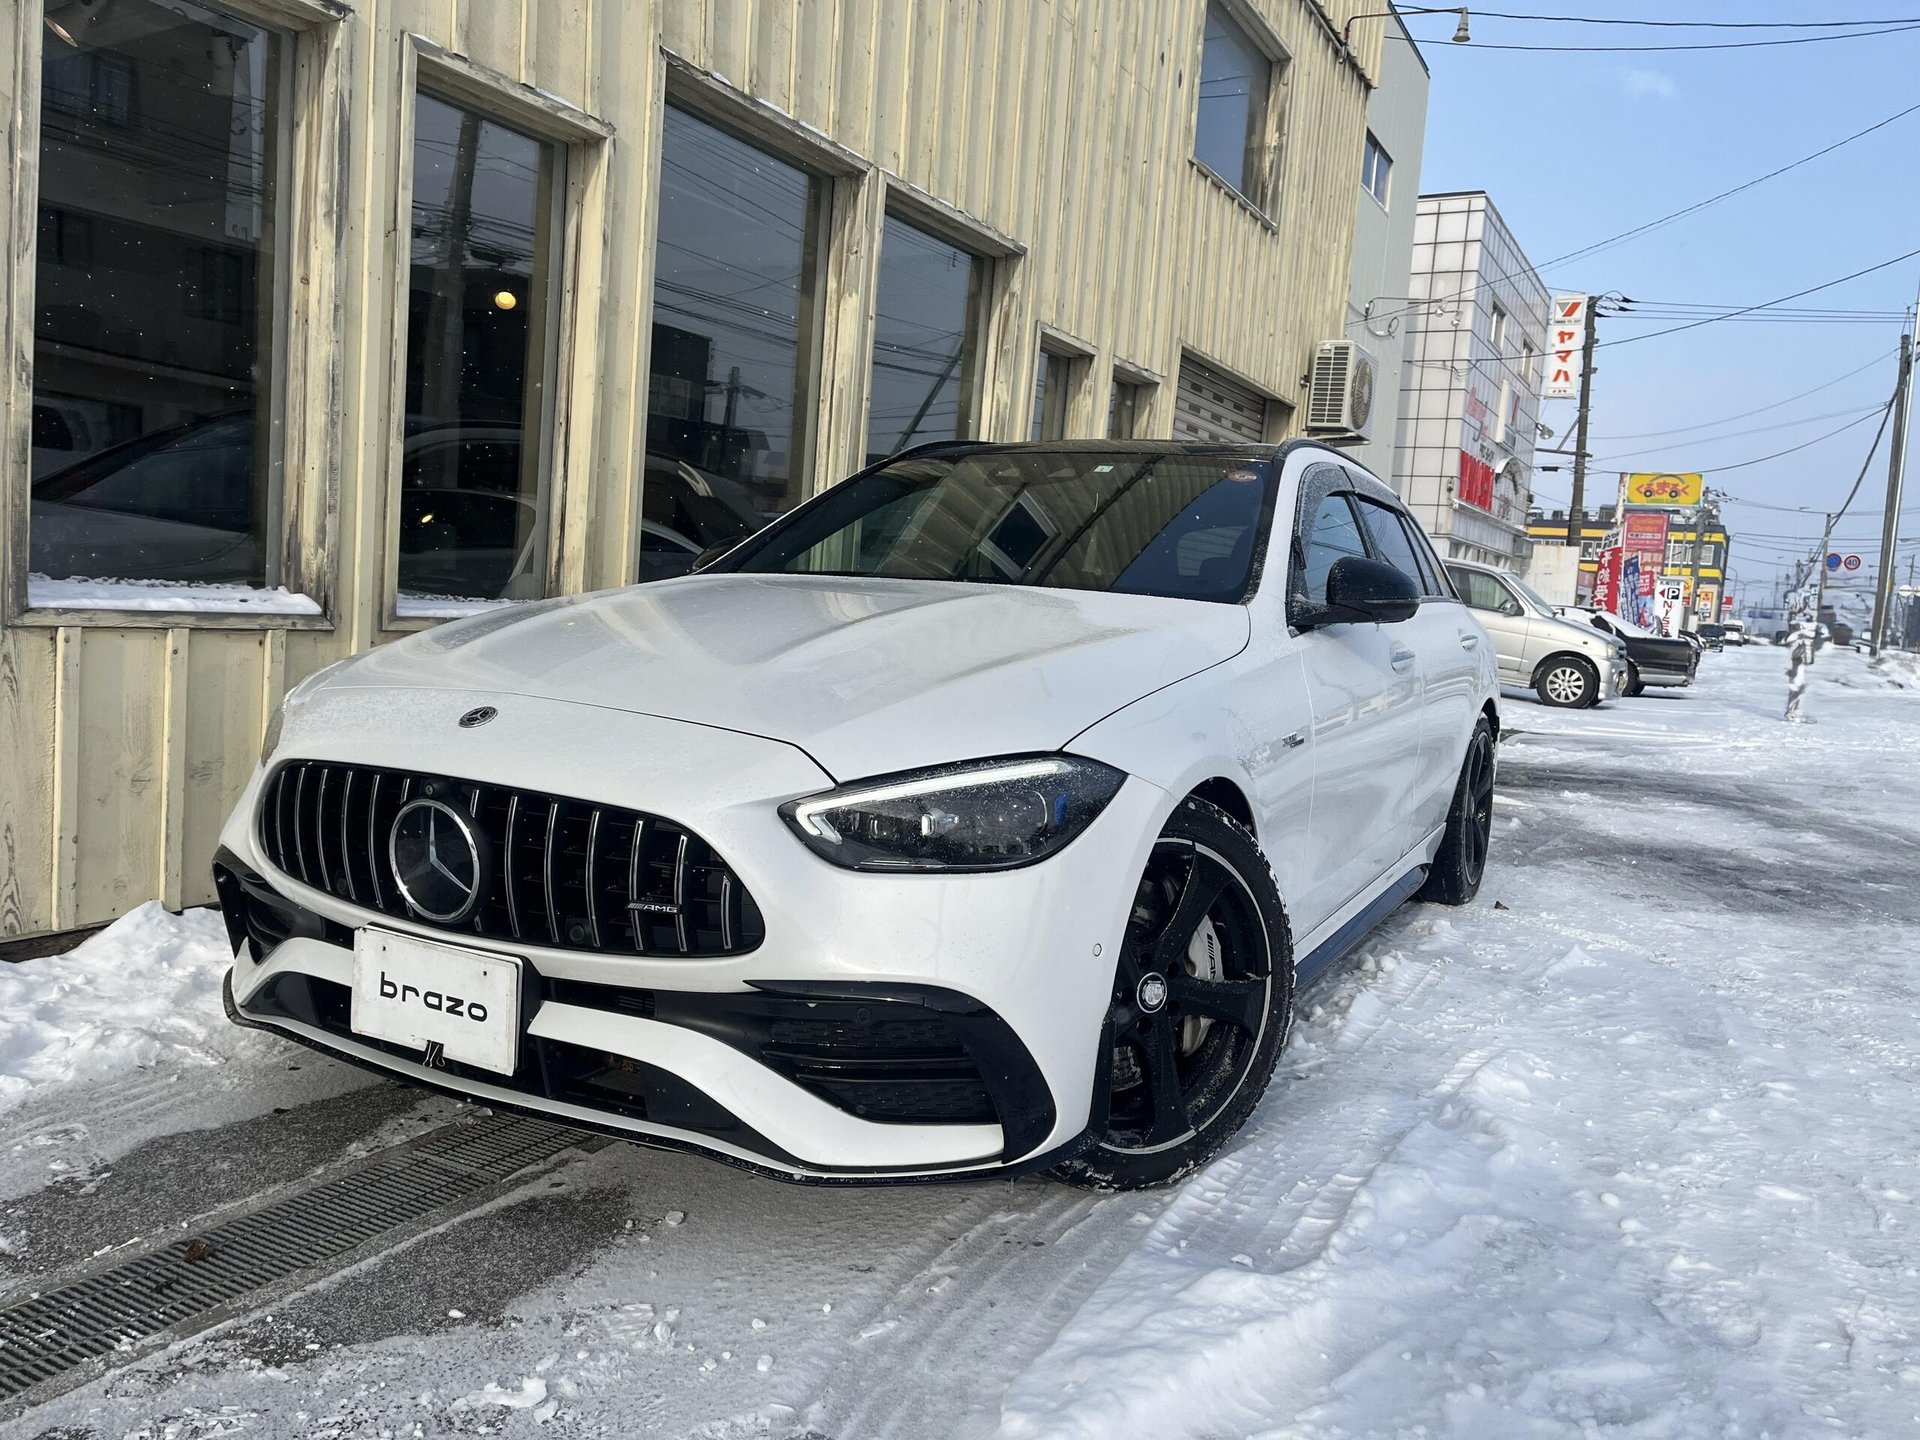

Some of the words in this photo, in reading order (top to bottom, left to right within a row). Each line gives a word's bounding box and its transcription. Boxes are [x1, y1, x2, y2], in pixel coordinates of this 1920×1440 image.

[1553, 331, 1574, 382] ヤマハ
[1668, 589, 1679, 599] P
[643, 904, 677, 913] AMG
[380, 971, 488, 1023] brazo
